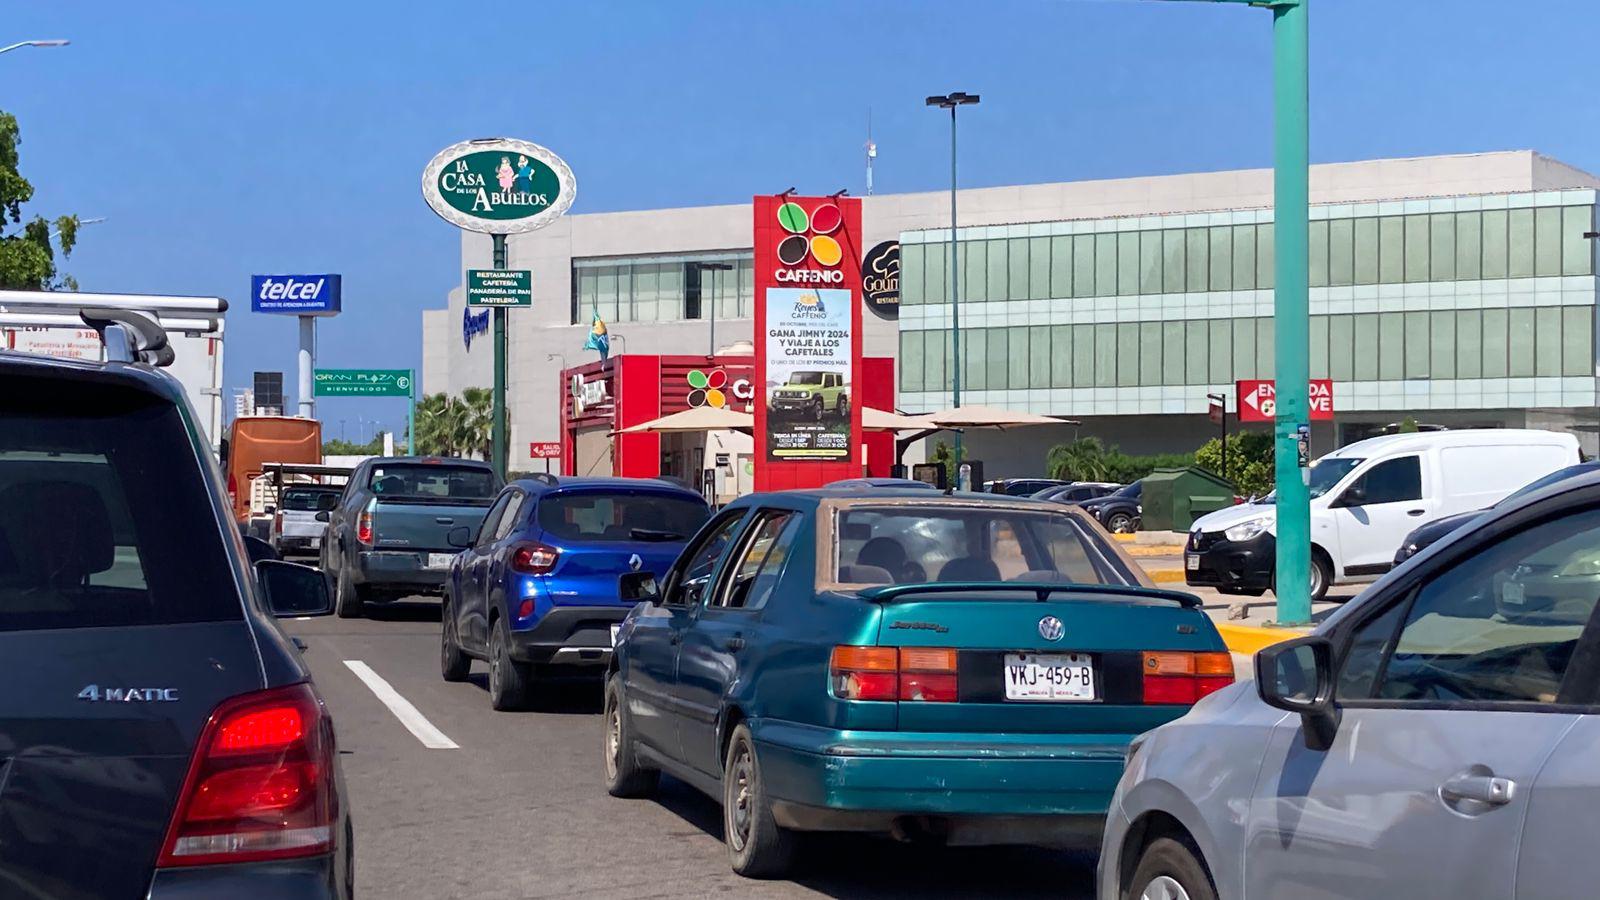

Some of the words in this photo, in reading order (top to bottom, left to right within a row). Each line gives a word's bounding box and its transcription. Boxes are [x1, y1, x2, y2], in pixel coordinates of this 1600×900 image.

[456, 160, 469, 172] LA
[442, 173, 486, 191] CASA
[774, 268, 844, 283] CAFFENIO
[260, 278, 325, 300] telcel
[769, 330, 796, 338] GANA
[798, 330, 826, 338] JIMNY
[1010, 666, 1090, 686] VKJ-459-B
